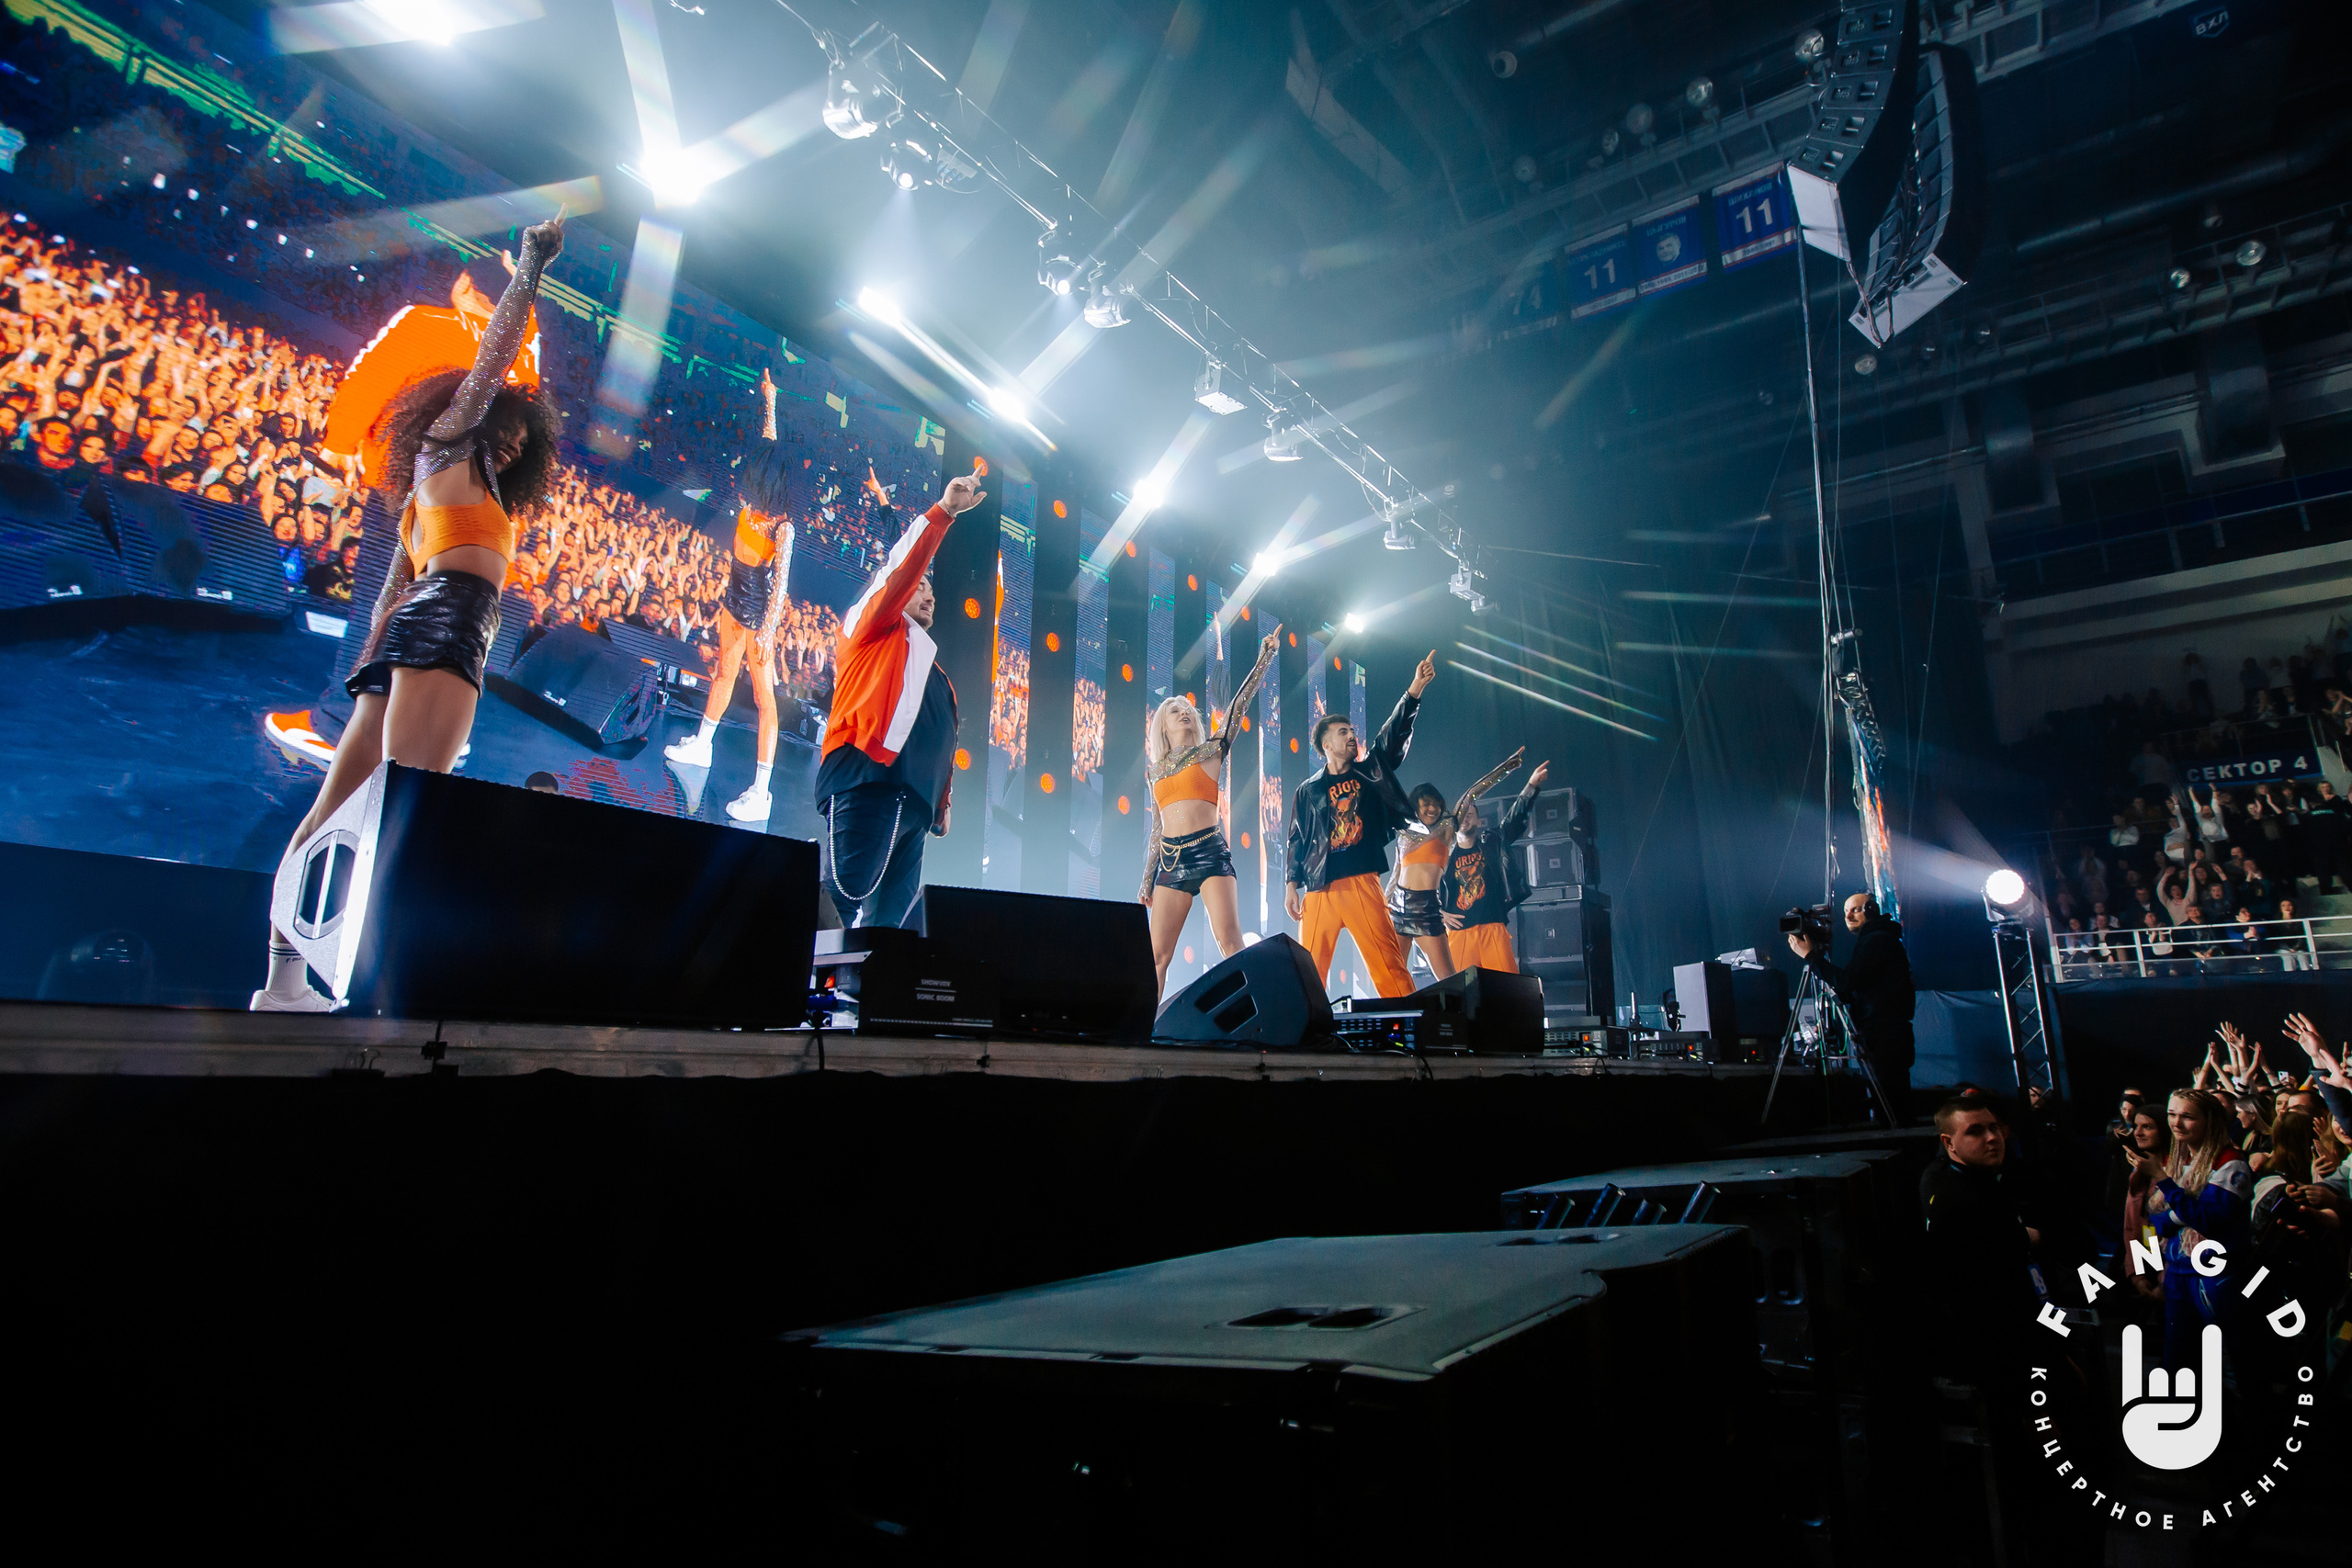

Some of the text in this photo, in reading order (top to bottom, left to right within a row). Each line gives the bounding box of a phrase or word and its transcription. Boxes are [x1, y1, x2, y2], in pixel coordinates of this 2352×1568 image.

[2195, 9, 2230, 36] ВХЛ
[1736, 197, 1773, 233] 11
[1584, 258, 1616, 290] 11
[2186, 755, 2309, 783] СЕКТОР 4
[917, 993, 935, 1001] SONIC
